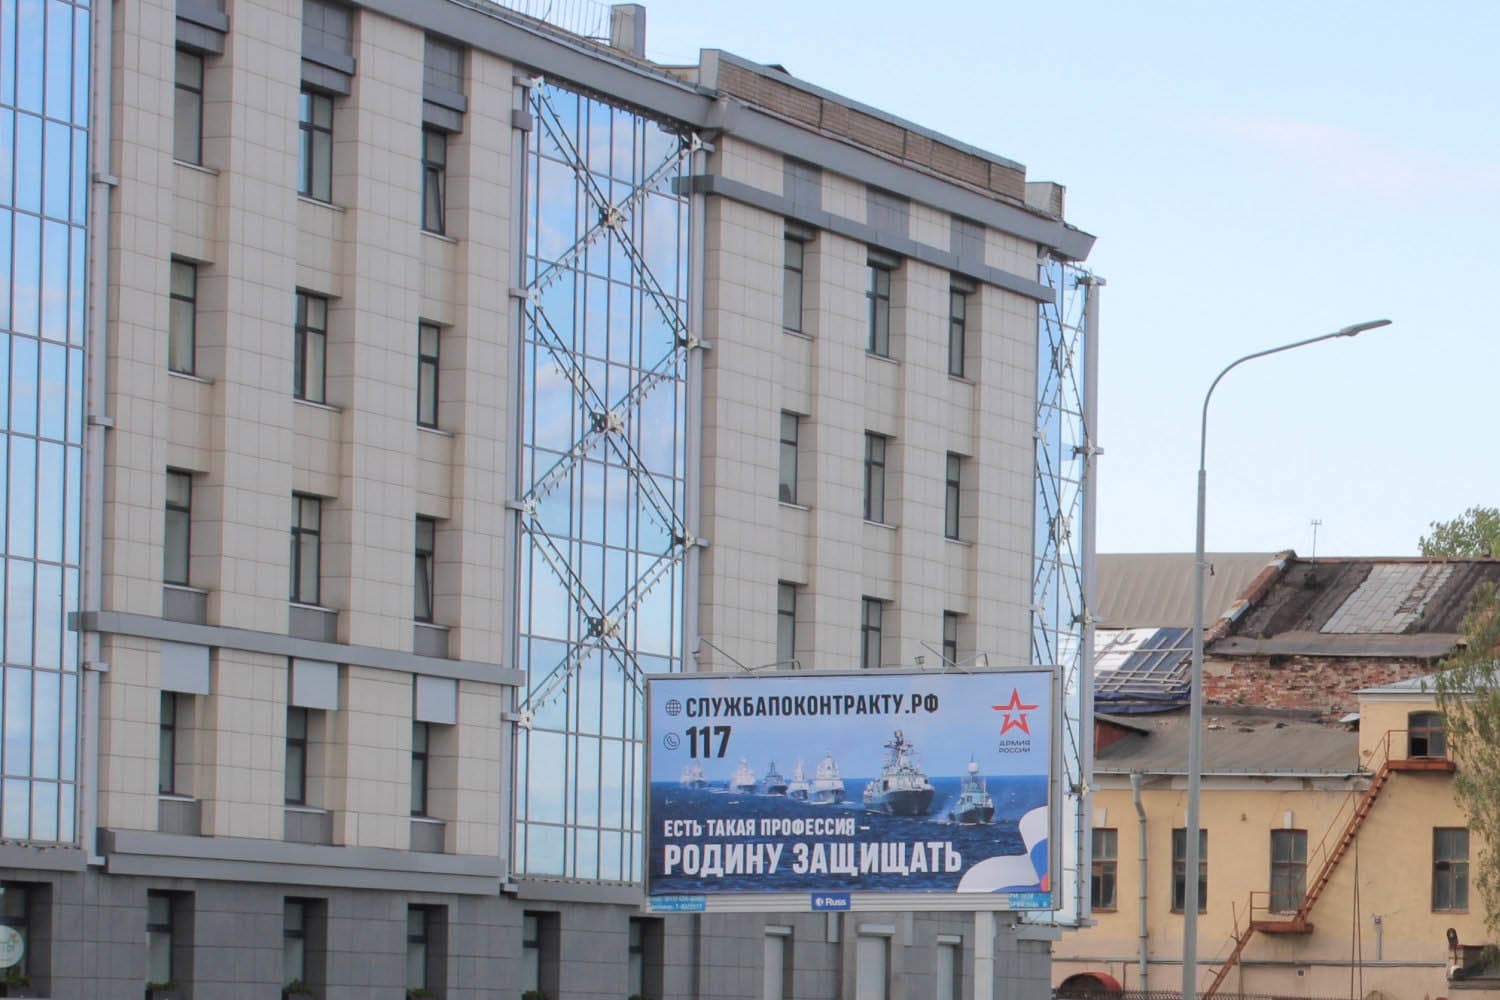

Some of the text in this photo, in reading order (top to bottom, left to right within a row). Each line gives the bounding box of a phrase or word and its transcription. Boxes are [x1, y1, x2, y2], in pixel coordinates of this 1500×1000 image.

[686, 693, 939, 718] СЛУЖБАПОКОНТРАКТУ.РФ
[685, 725, 732, 758] 117
[664, 818, 702, 837] ЕСТЬ
[706, 818, 756, 837] ТАКАЯ
[760, 817, 856, 836] ПРОФЕССИЯ
[664, 841, 962, 878] РОДИНУ ЗАЩИЩАТЬ
[825, 897, 847, 907] Russ
